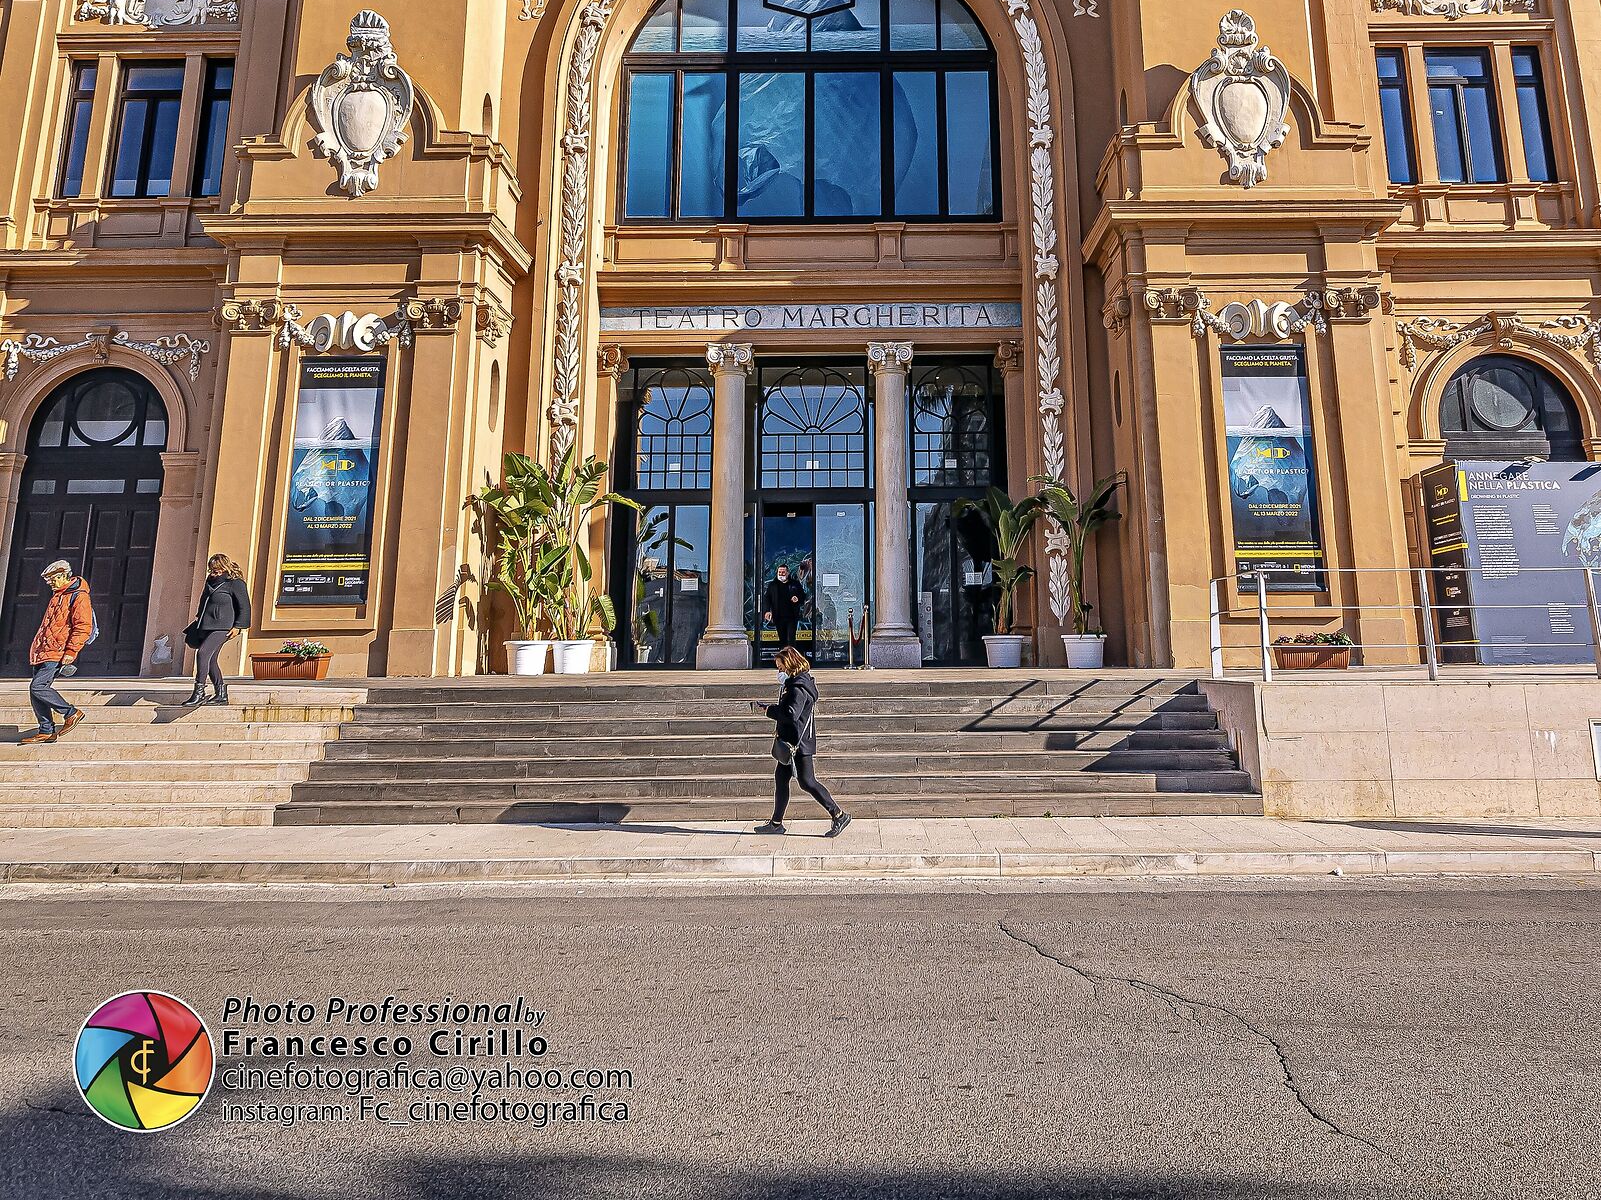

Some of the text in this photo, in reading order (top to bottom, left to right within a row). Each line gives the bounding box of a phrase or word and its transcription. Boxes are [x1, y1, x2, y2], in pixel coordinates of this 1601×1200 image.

[631, 305, 993, 329] TEATRO MARGHERITA
[1468, 472, 1530, 480] ANNEGARE
[1469, 481, 1561, 490] NELLA PLASTICA
